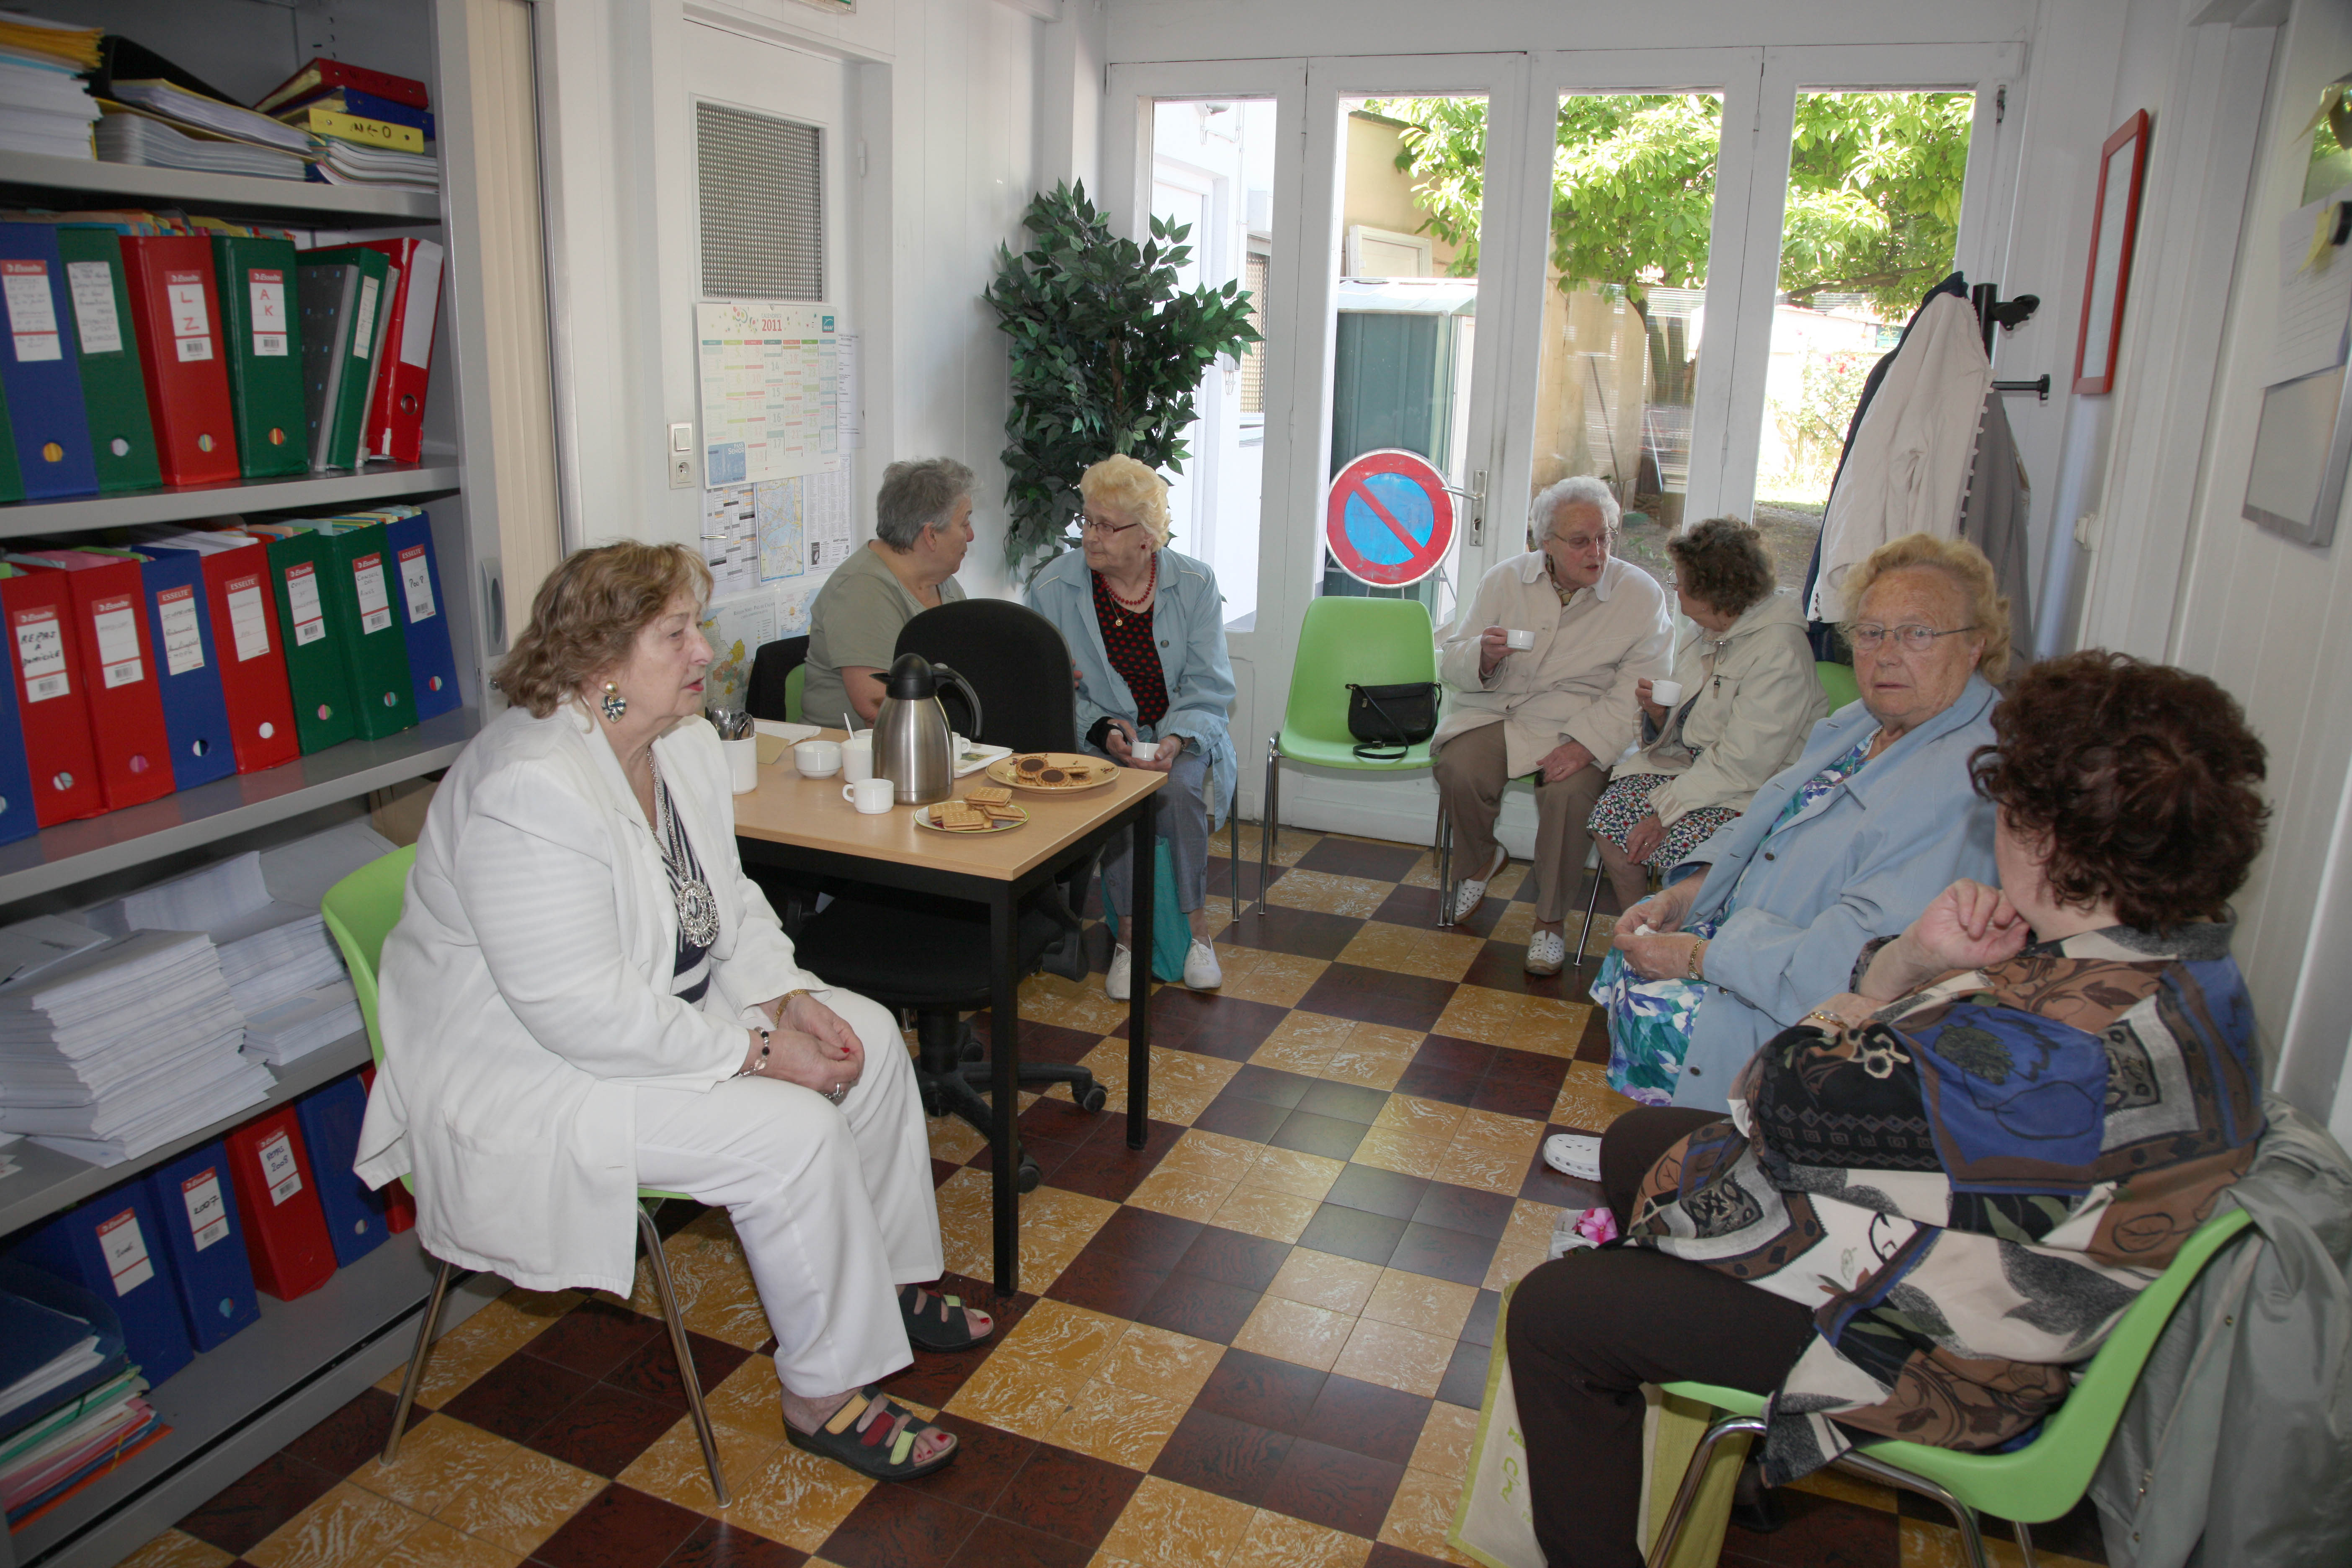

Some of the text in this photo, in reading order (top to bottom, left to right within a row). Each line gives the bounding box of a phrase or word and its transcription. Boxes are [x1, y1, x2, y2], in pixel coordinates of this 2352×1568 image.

[181, 291, 193, 303] L
[260, 289, 270, 300] A
[264, 305, 273, 316] K
[183, 317, 199, 331] Z
[762, 319, 782, 331] 2011
[771, 362, 779, 371] 14
[772, 388, 780, 397] 15
[773, 413, 781, 423] 16
[774, 439, 781, 449] 17
[402, 548, 421, 559] ESSELTE
[362, 558, 379, 567] Esselte
[295, 567, 312, 576] Esselte
[230, 578, 255, 590] ESSELTE
[162, 589, 188, 601] ESSELTE
[106, 601, 129, 610] Esselte
[28, 611, 54, 622] Esselte
[266, 1130, 285, 1144] Esselte
[271, 1155, 289, 1172] 2008
[192, 1173, 213, 1185] Esselte
[194, 1195, 220, 1215] 2007
